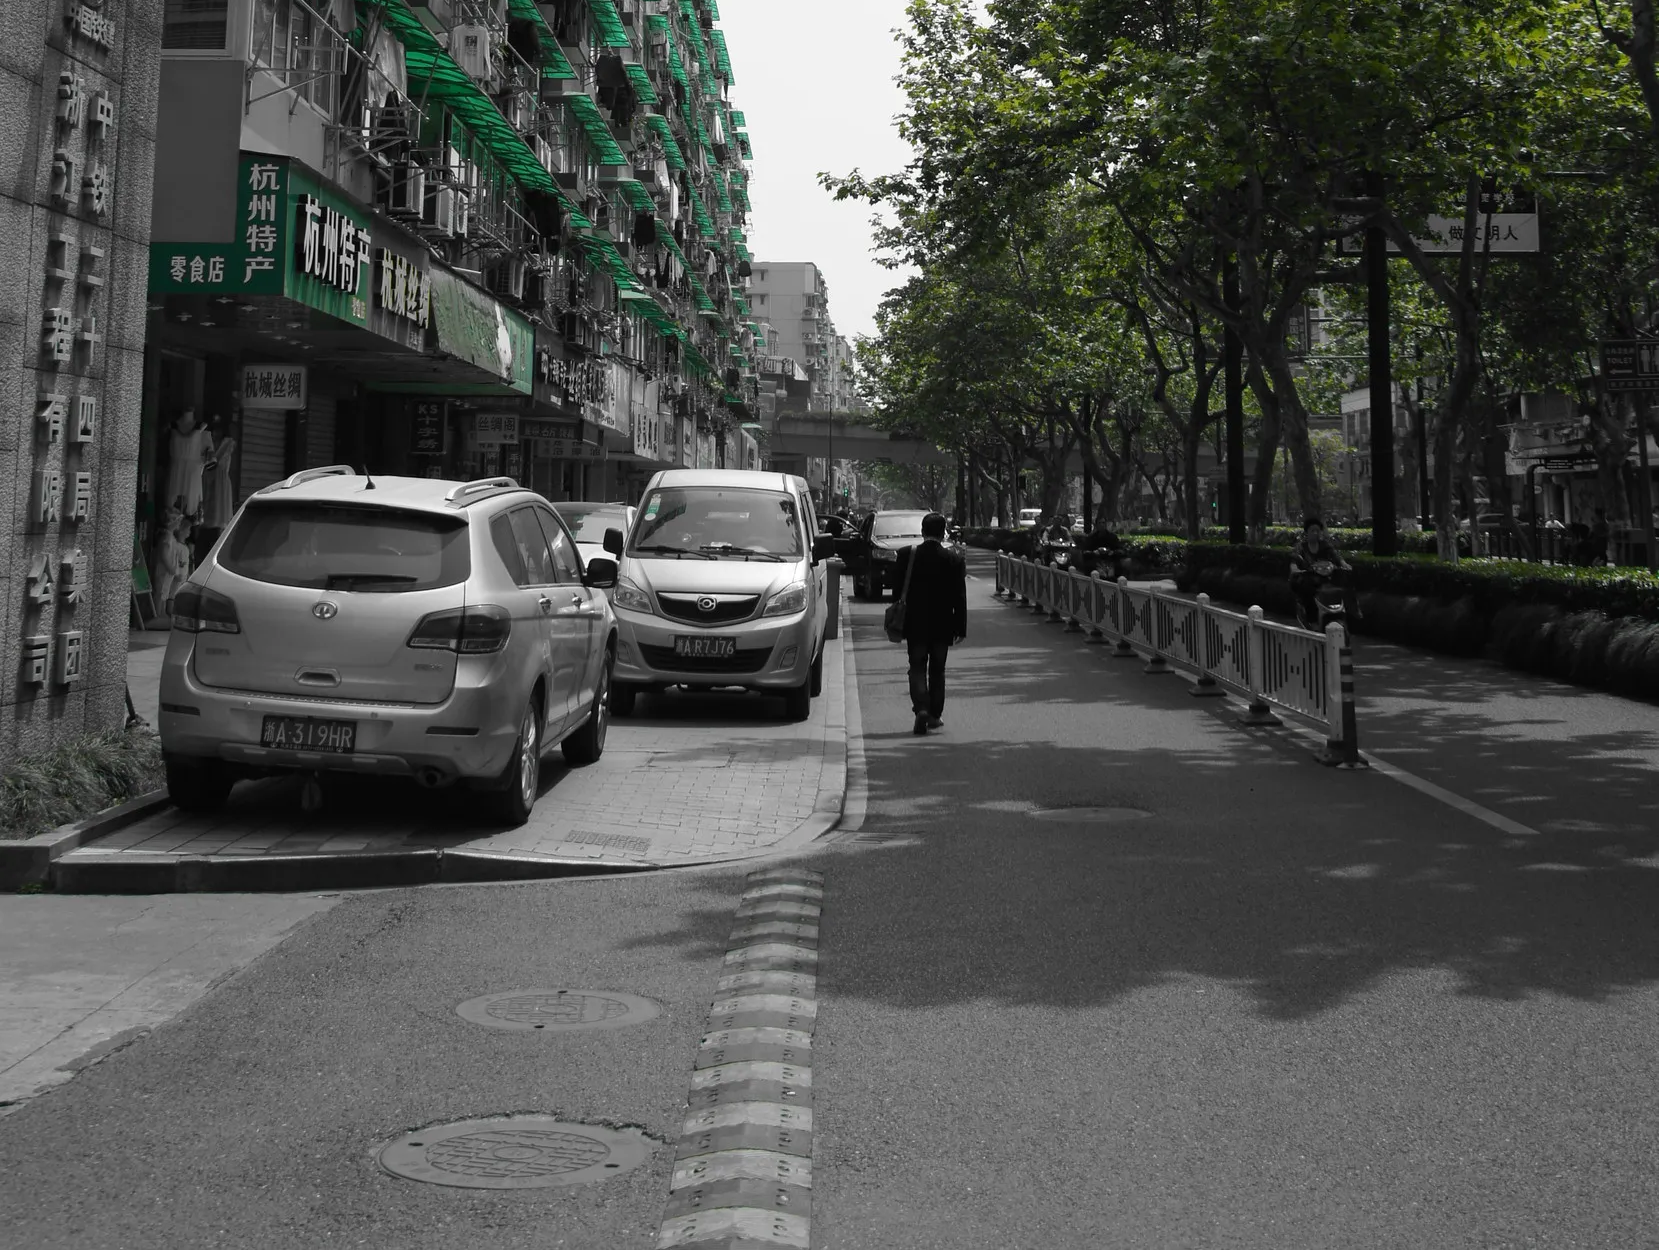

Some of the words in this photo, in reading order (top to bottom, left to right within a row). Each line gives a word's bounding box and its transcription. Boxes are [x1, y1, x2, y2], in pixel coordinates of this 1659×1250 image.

[68, 3, 115, 49] 中国铁建
[244, 163, 280, 283] 杭州特产
[303, 194, 371, 293] 杭州特产
[170, 256, 225, 283] 零食店
[380, 248, 431, 329] 杭城丝绸
[24, 71, 86, 687] 浙江工程有限公司
[58, 90, 113, 683] 中铁二十四局集团
[245, 371, 301, 398] 杭城丝绸
